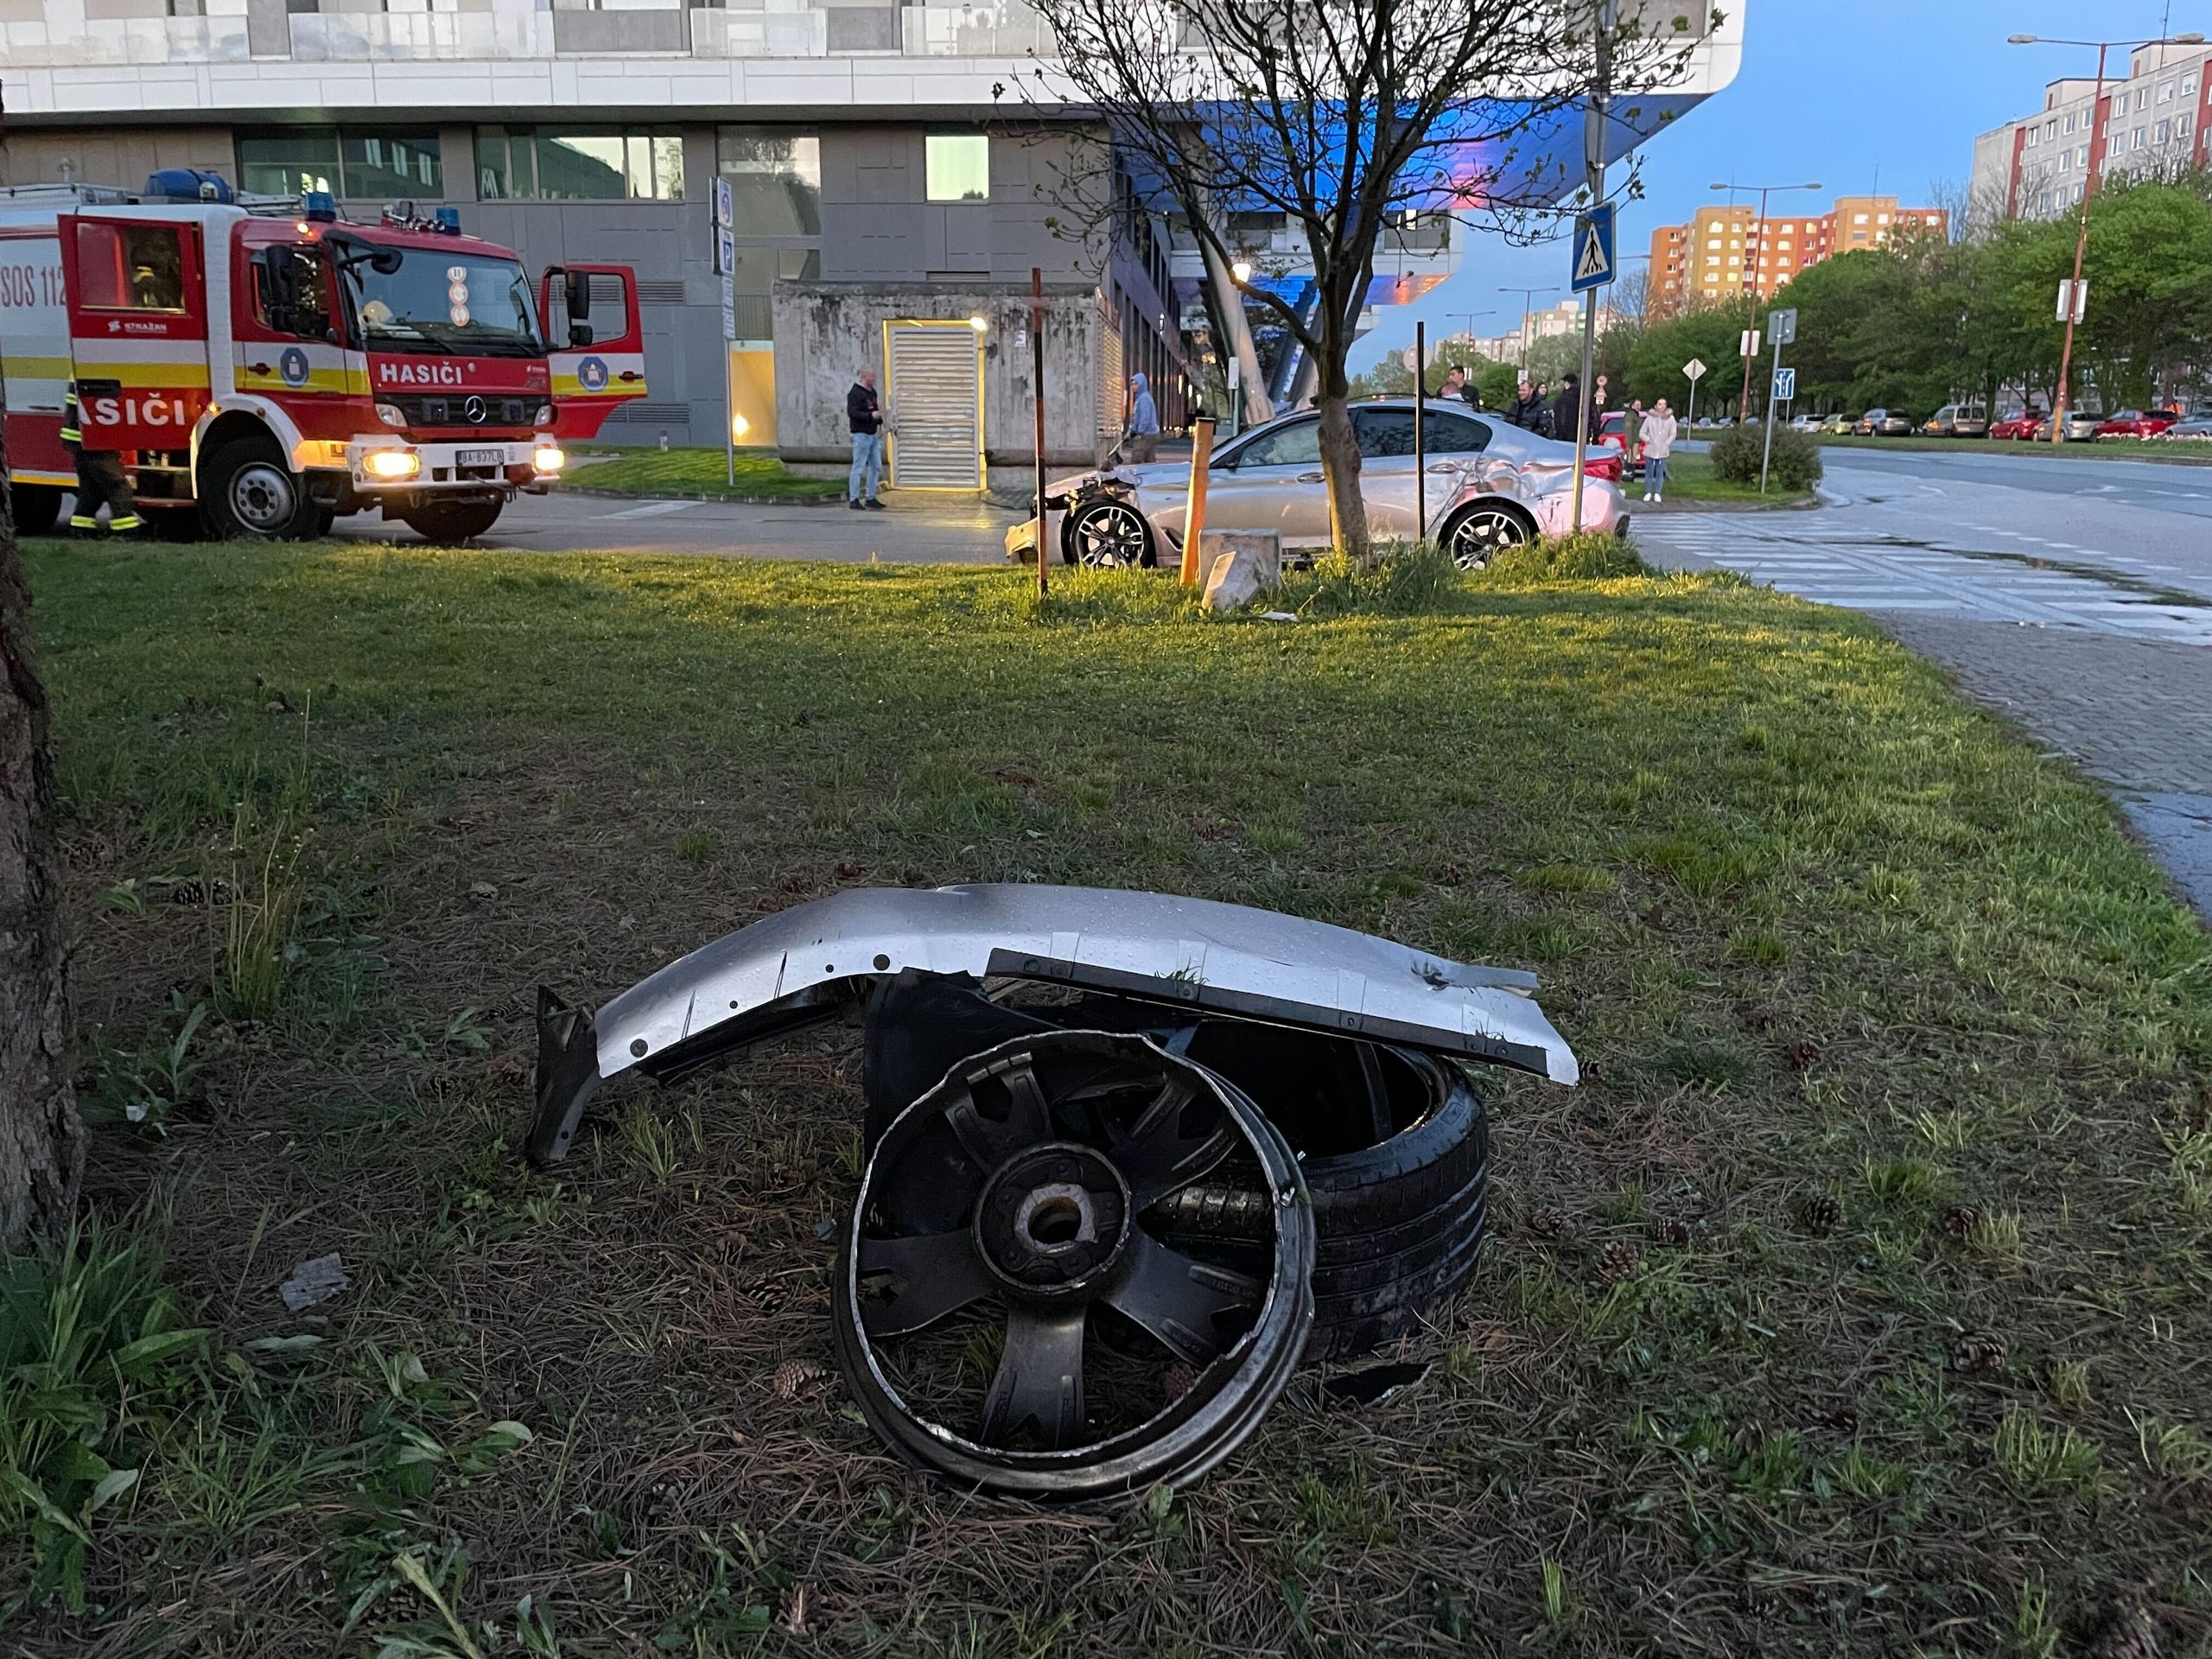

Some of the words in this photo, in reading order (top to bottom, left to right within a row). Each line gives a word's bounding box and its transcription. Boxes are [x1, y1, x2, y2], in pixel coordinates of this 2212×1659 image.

[1, 264, 35, 308] SOS
[41, 265, 67, 307] 112
[380, 360, 462, 385] HASIČI
